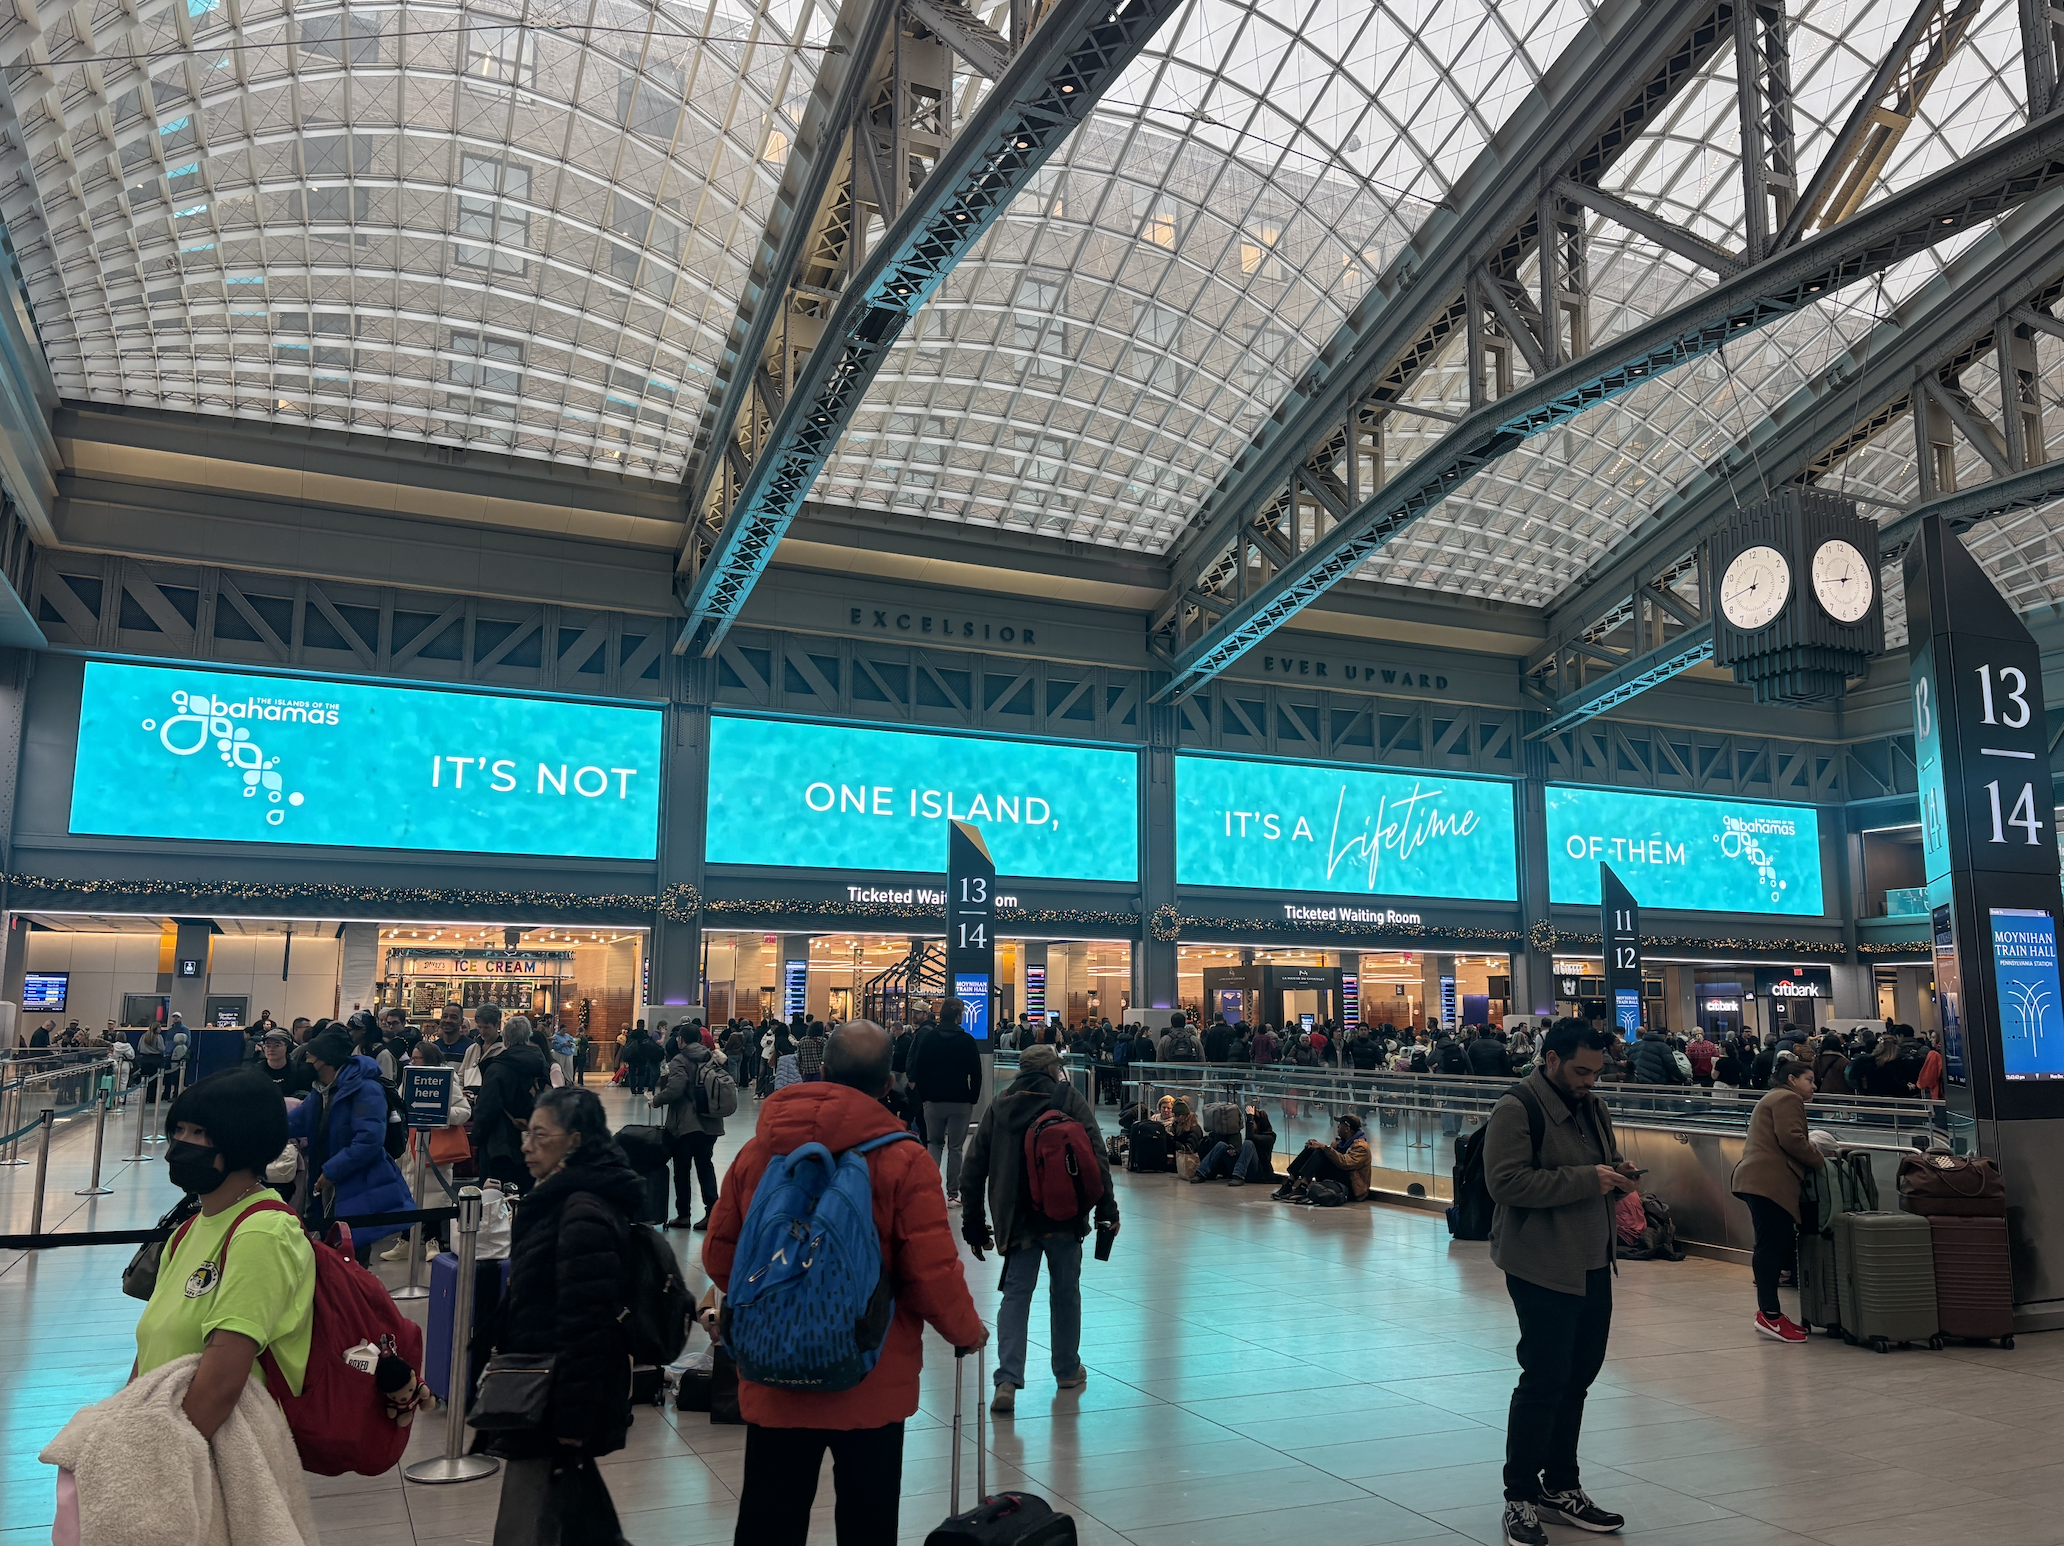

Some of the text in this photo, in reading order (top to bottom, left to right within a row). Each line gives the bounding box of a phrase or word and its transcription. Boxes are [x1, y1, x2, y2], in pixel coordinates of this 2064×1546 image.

[1766, 550, 1770, 558] 1
[1825, 545, 1831, 554] 11
[1837, 544, 1844, 553] 12
[1852, 550, 1855, 558] 1
[1749, 550, 1757, 560] 12
[1816, 556, 1824, 565] 10
[1736, 559, 1743, 567] 11
[1776, 559, 1781, 568] 2
[1860, 564, 1865, 572] 2
[1727, 574, 1734, 583] 10
[1780, 575, 1785, 584] 3
[1815, 572, 1820, 581] 9
[1865, 581, 1869, 589] 3
[1777, 592, 1782, 600] 4
[1820, 589, 1825, 598] 8
[1862, 596, 1866, 604] 4
[1729, 606, 1734, 615] 8
[1767, 607, 1772, 616] 5
[1830, 602, 1834, 611] 7
[1854, 607, 1858, 616] 5
[1740, 615, 1744, 624] 7
[1842, 610, 1847, 618] 6
[1754, 616, 1759, 624] 6
[850, 607, 1036, 645] EXCELSIOR
[1264, 656, 1448, 690] EVER UPWARD
[1975, 664, 2031, 729] 13
[256, 697, 272, 705] THE
[274, 698, 310, 708] ISLANDS
[325, 702, 340, 710] THE
[1914, 676, 1931, 742] 13
[210, 693, 339, 726] bahamas
[432, 755, 637, 799] IT'S NOT
[805, 782, 1059, 831] ONE ISLAND,
[1983, 779, 2044, 846] 14
[1739, 816, 1796, 836] bahamas
[1923, 787, 1942, 855] 14
[1225, 781, 1480, 890] IT'S A Lifetime
[1566, 834, 1685, 866] OF THEM
[960, 877, 987, 903] 13
[847, 886, 912, 904] Ticketed
[995, 896, 1018, 907] om
[1284, 905, 1421, 925] Ticketed Waiting Room
[1614, 909, 1633, 931] 11
[958, 922, 987, 949] 14
[1994, 931, 2053, 944] MOYNIHAN
[1994, 944, 2056, 957] TRAIN HALL
[1615, 947, 1636, 969] 12
[455, 960, 478, 972] ICE
[485, 961, 536, 973] CREAM
[1772, 980, 1819, 997] citibank
[1706, 999, 1739, 1012] citibank
[414, 1075, 444, 1086] Enter
[415, 1087, 440, 1098] here
